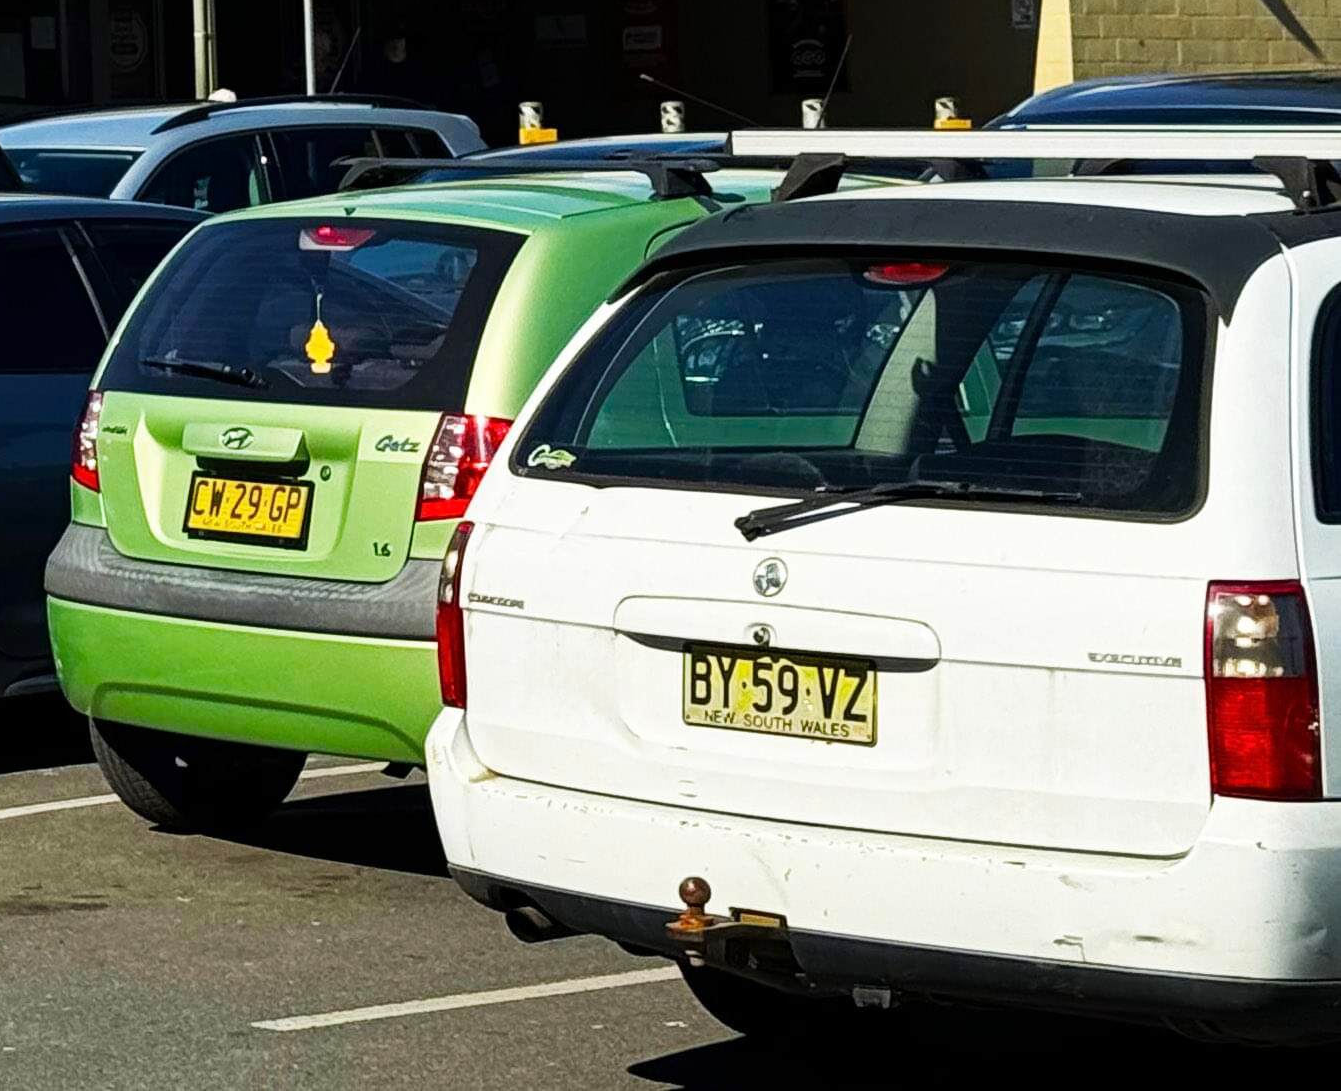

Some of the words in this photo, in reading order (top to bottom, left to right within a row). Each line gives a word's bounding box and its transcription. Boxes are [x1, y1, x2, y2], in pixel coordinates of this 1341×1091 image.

[375, 435, 421, 452] Getz
[704, 709, 736, 724] NEW
[743, 714, 792, 731] SOUTH
[800, 719, 850, 737] WALES
